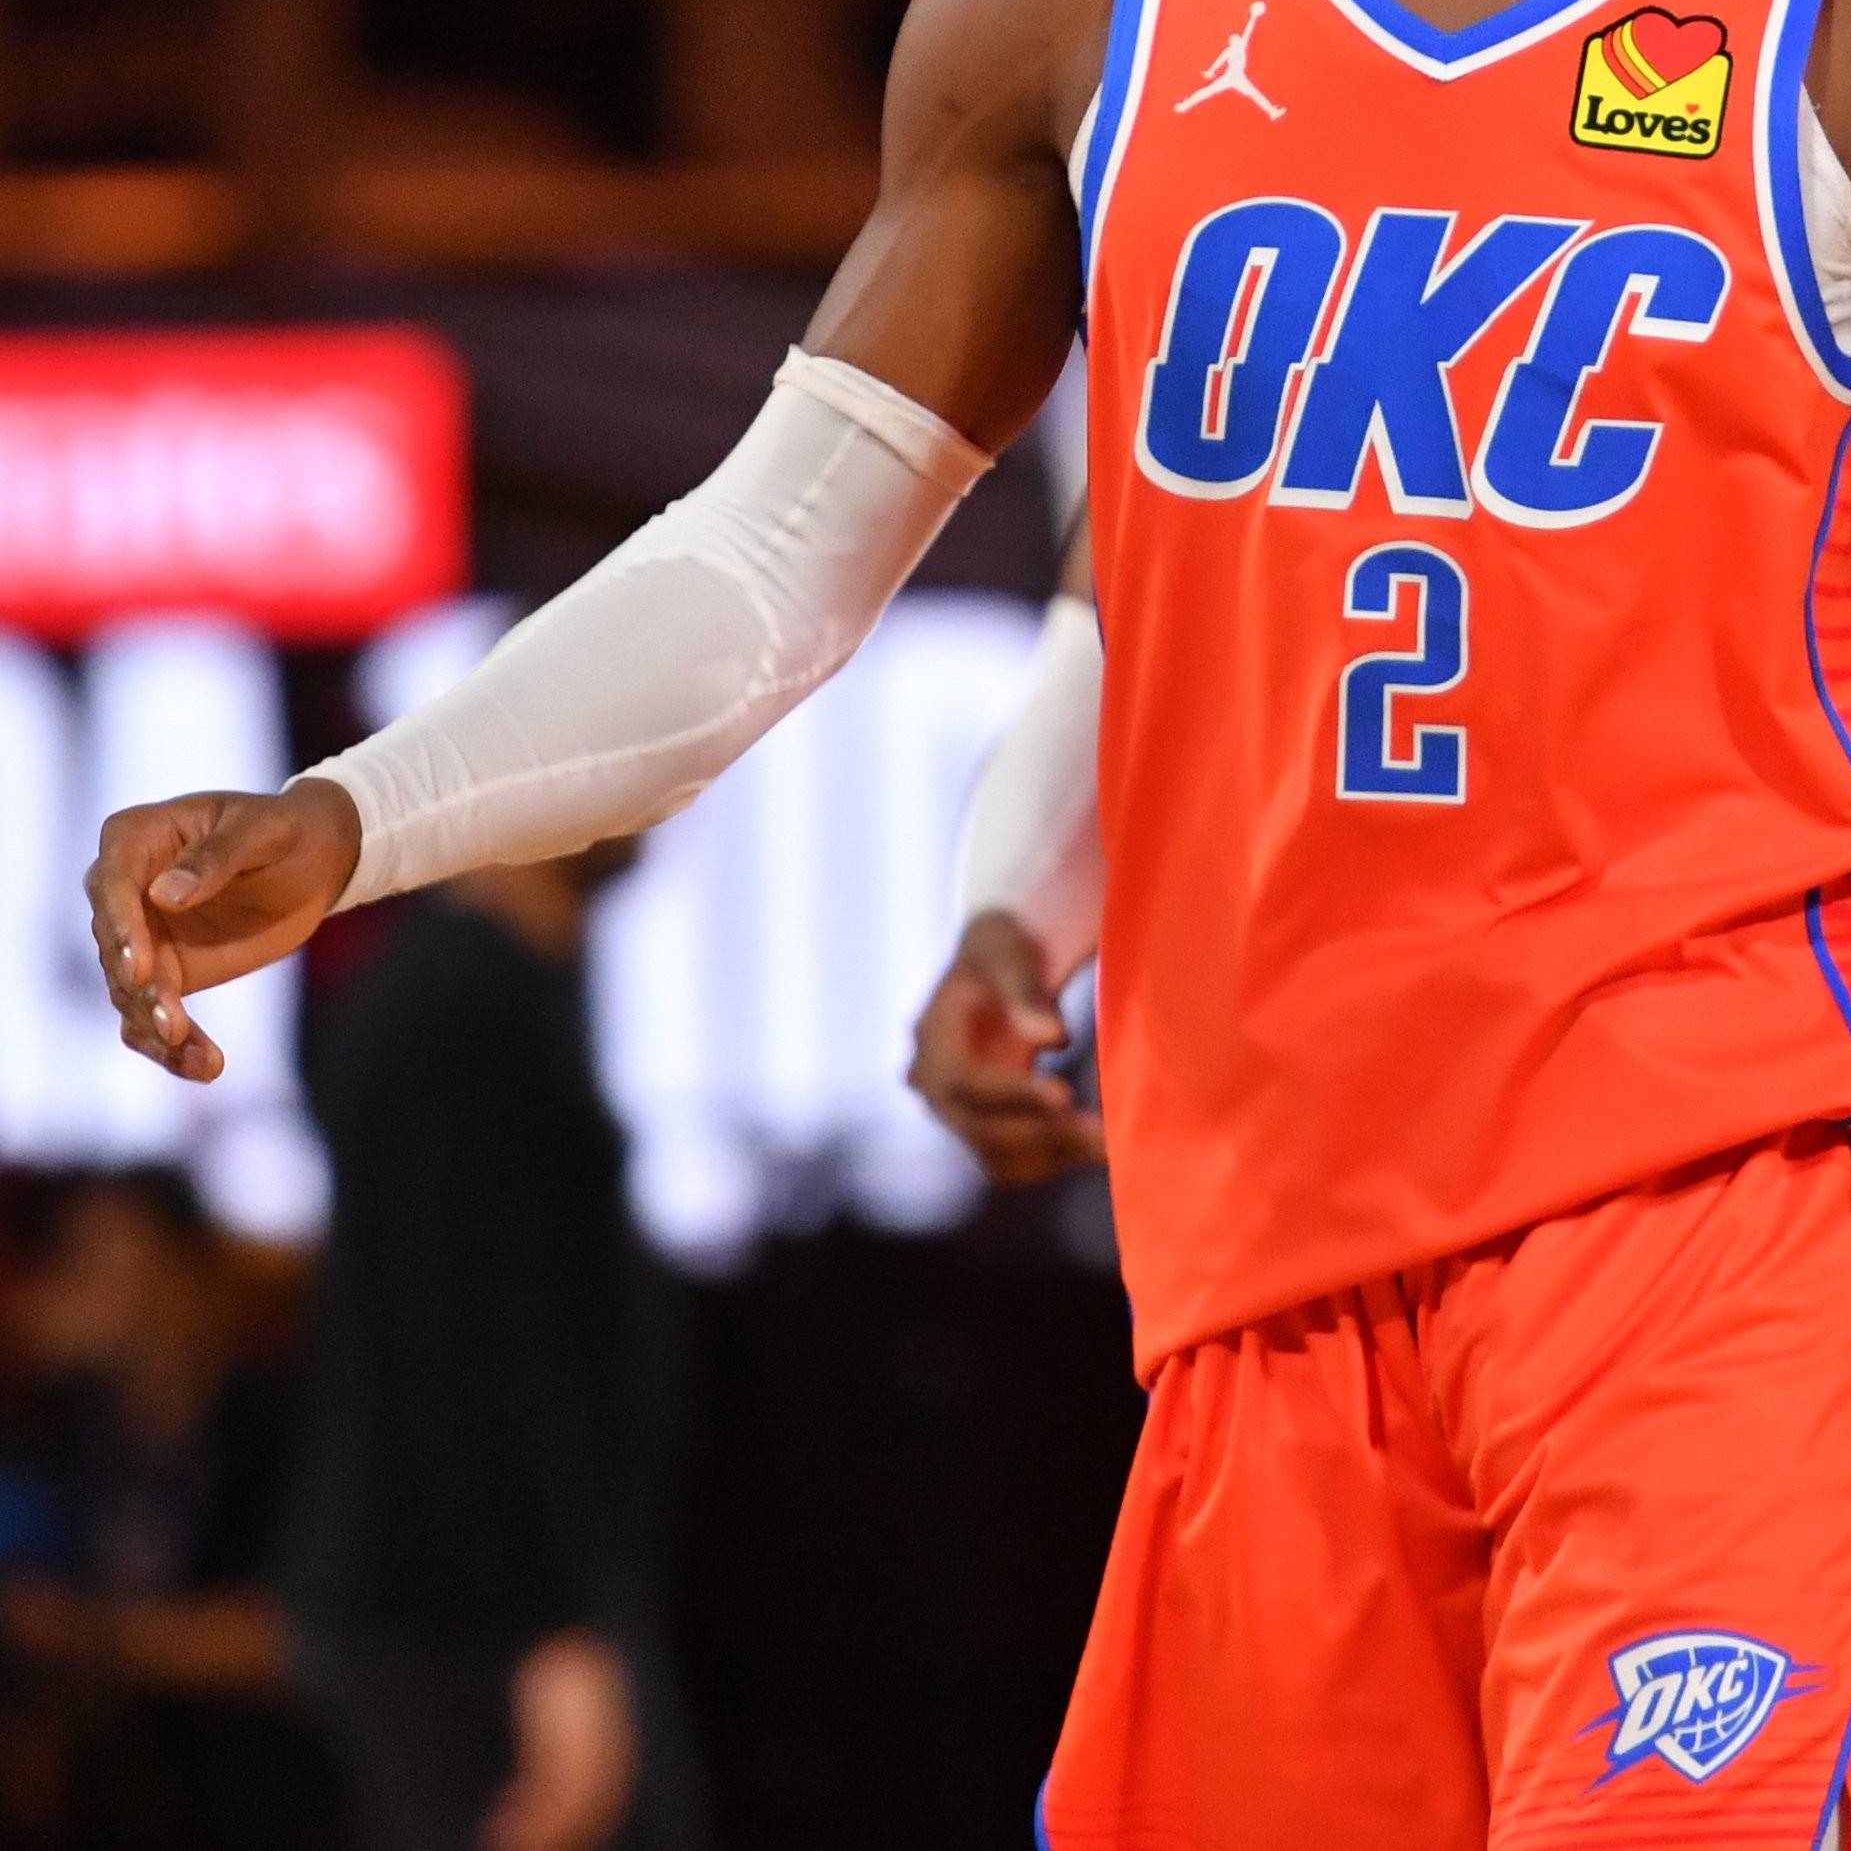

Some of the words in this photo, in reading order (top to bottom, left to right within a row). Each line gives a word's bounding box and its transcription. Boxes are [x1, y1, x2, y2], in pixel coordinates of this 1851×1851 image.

[1134, 196, 1732, 529] OKC
[1336, 540, 1469, 806] 2
[1611, 1657, 1750, 1756] OKC
